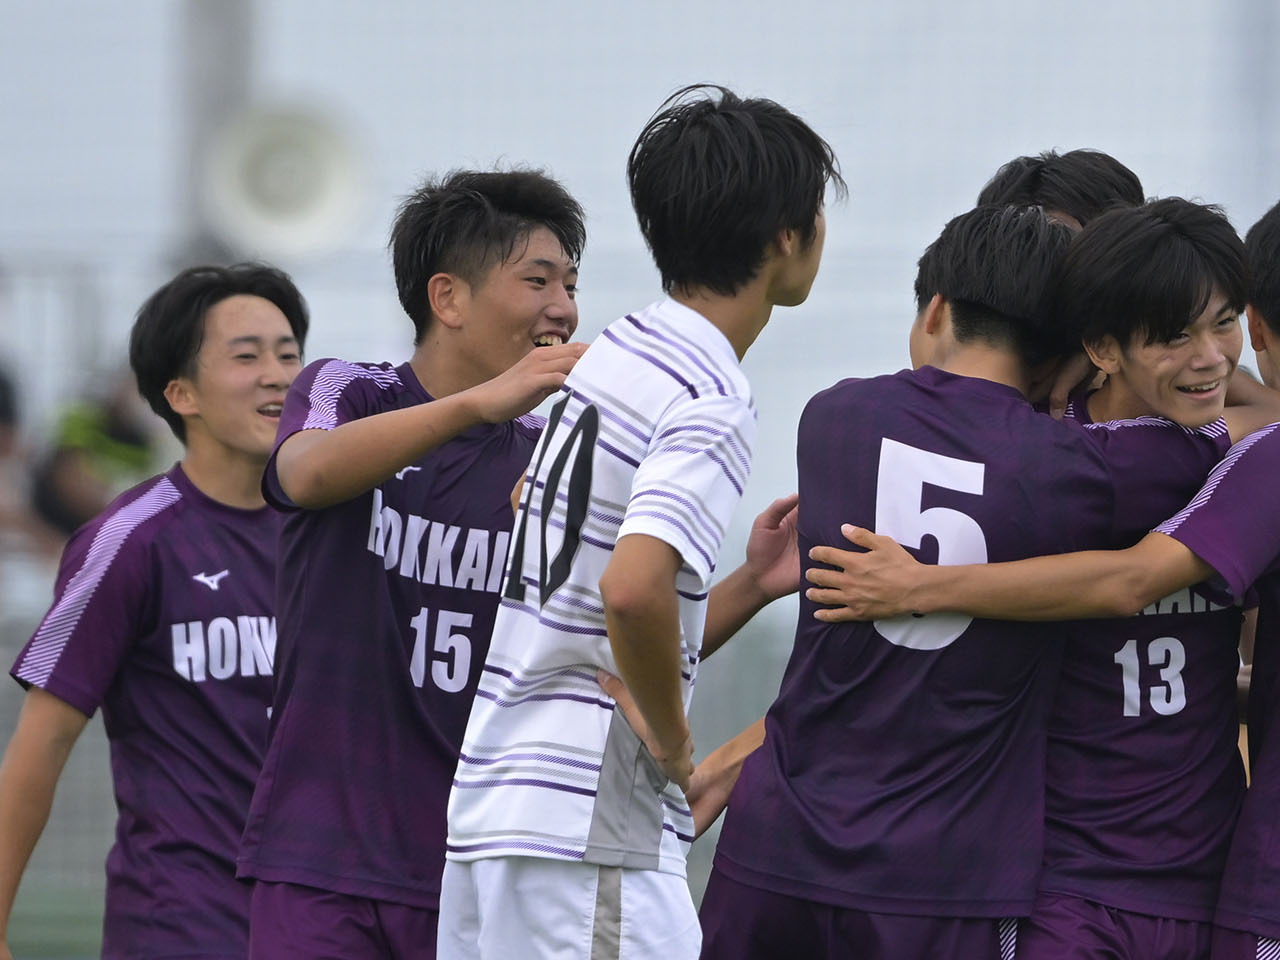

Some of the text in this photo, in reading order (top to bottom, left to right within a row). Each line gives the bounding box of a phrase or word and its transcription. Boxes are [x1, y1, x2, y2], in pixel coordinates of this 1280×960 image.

[502, 388, 600, 611] 10
[873, 437, 988, 651] 5
[409, 607, 474, 693] 15
[1114, 637, 1187, 717] 13
